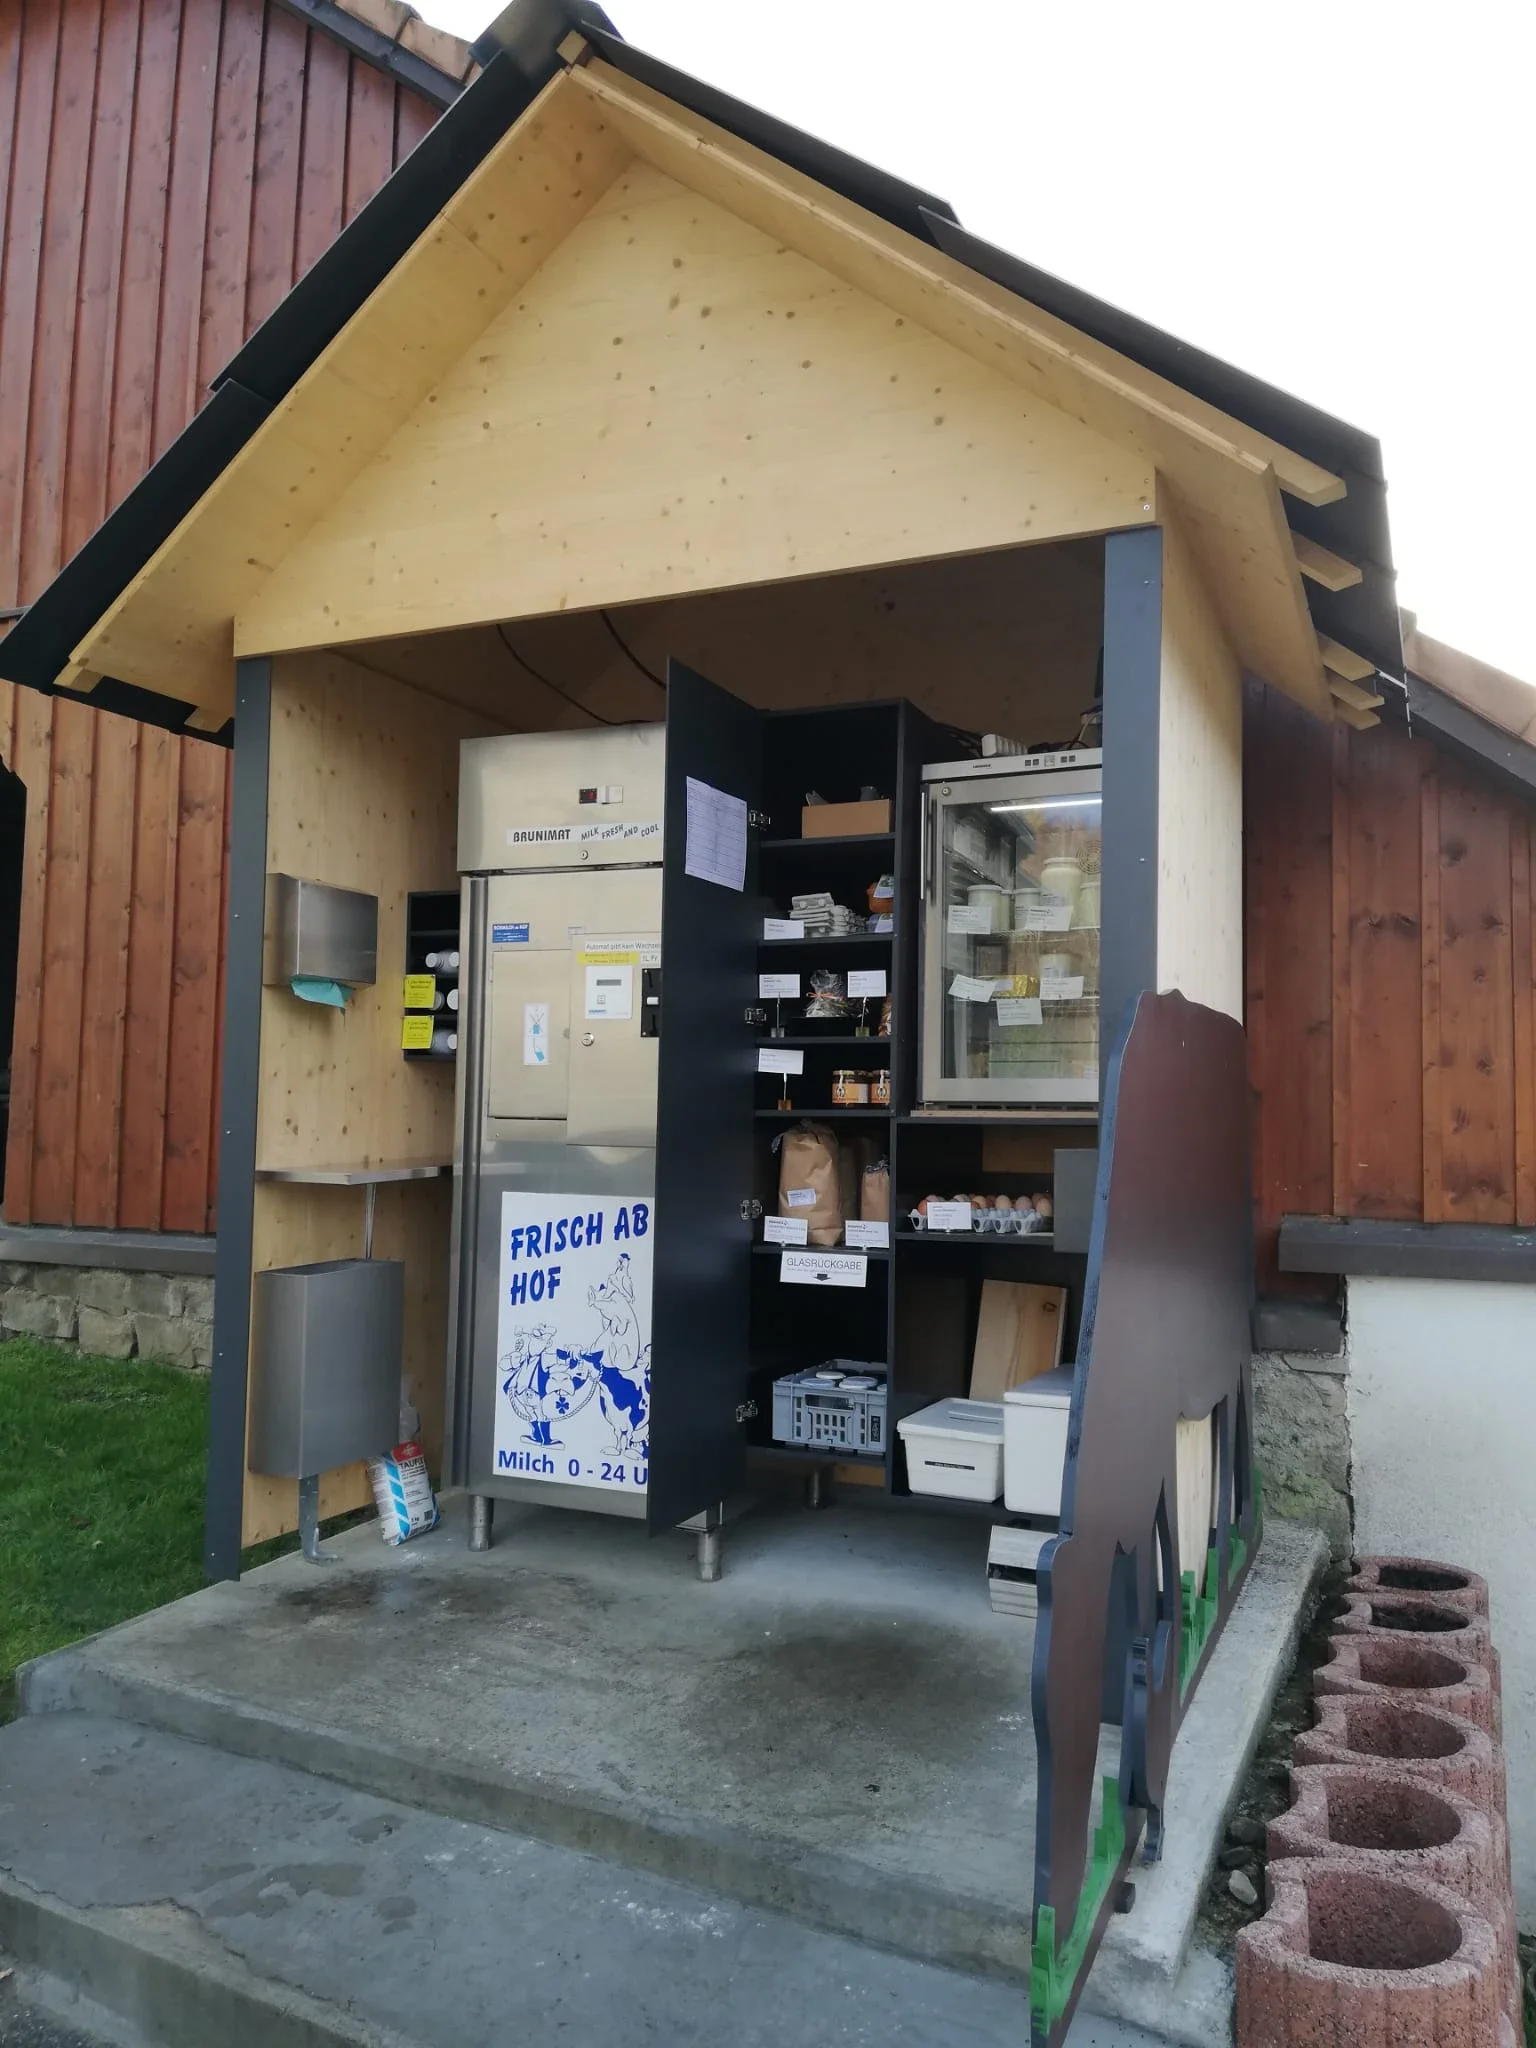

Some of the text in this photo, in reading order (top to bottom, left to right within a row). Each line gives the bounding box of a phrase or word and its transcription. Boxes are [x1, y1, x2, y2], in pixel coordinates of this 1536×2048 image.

[513, 823, 660, 842] BRUNIMAT MILK FRESH AND COOL
[511, 1203, 649, 1261] FRISCH AB
[786, 1257, 862, 1270] GLASRÜCKGABE
[510, 1266, 561, 1306] HOF
[498, 1450, 554, 1474] Milch
[568, 1459, 579, 1477] 0
[601, 1463, 626, 1483] 24
[634, 1467, 648, 1486] U
